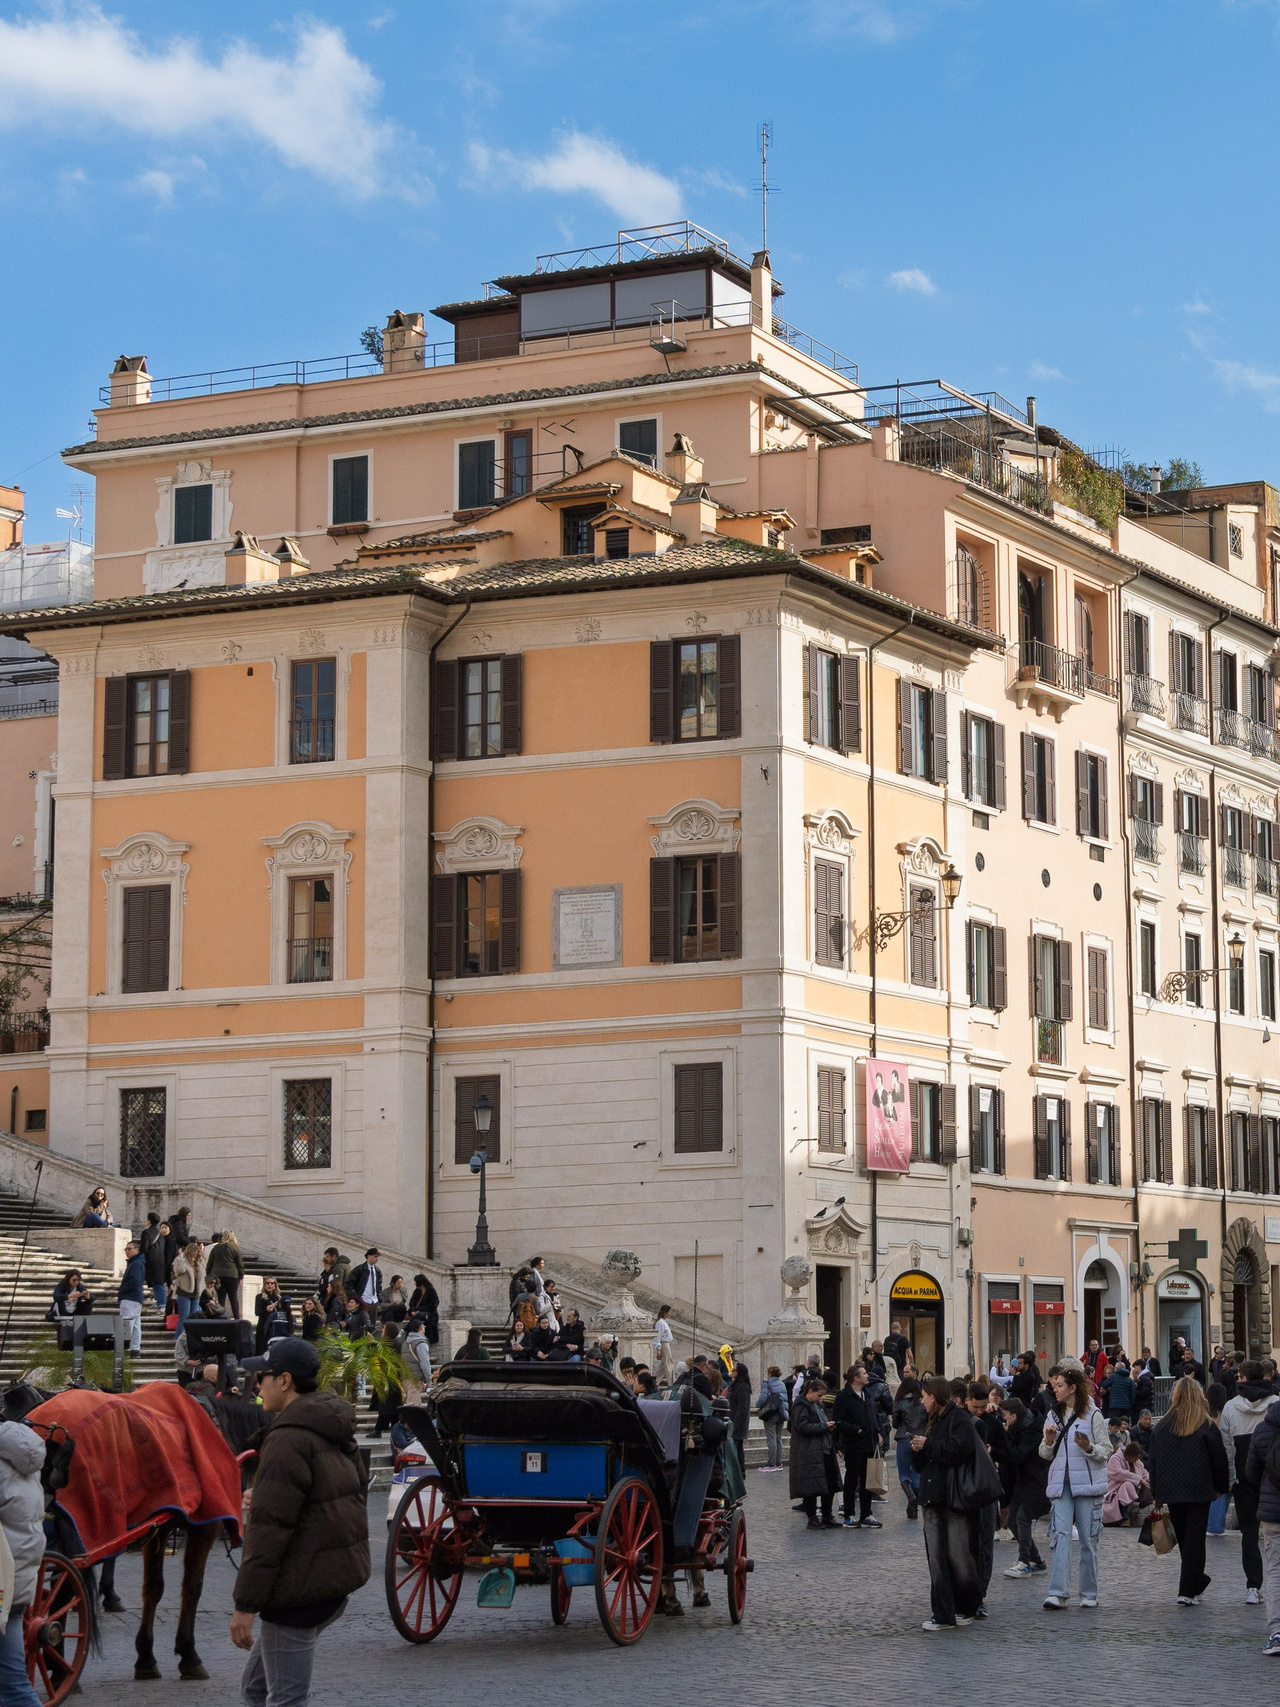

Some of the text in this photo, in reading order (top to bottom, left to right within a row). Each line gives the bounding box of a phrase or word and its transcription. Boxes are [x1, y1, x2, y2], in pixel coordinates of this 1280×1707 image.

[894, 1286, 913, 1295] ACQUA
[919, 1287, 938, 1296] PARMA
[531, 1460, 538, 1468] 11
